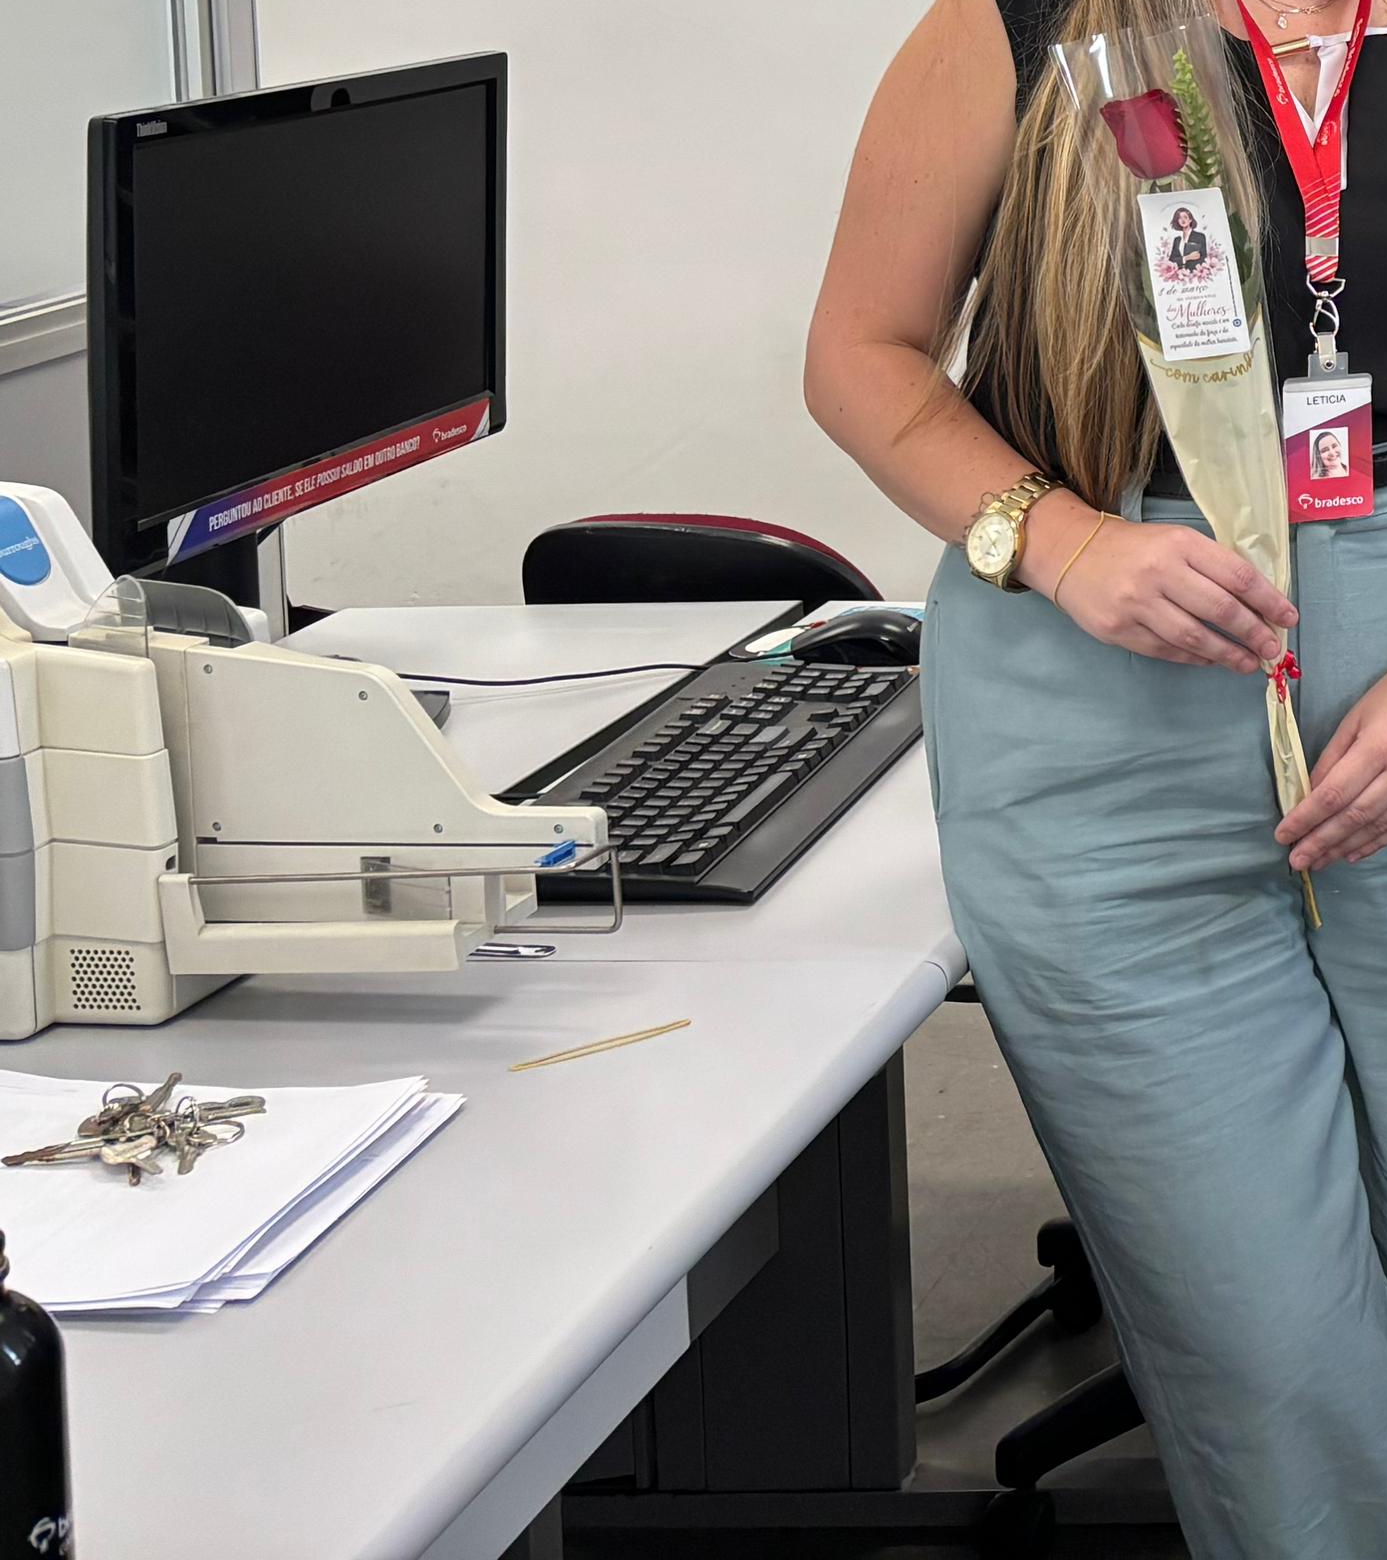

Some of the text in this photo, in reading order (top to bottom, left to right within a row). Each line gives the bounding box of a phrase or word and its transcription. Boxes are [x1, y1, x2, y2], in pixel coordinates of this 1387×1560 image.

[1166, 300, 1227, 321] Mulheres
[1202, 347, 1256, 383] carinh
[1306, 394, 1346, 406] LETICIA
[441, 424, 467, 440] bradesco
[208, 502, 252, 532] PERGUNTOU
[252, 497, 263, 514] AO
[294, 480, 304, 497] SE
[304, 475, 316, 493] ELE
[316, 467, 341, 487] POSSUI
[340, 458, 363, 478] SALDO
[364, 453, 374, 470] EM
[375, 446, 395, 465] OUTRO
[1315, 495, 1364, 509] bradesco
[0, 536, 39, 558] urroughs
